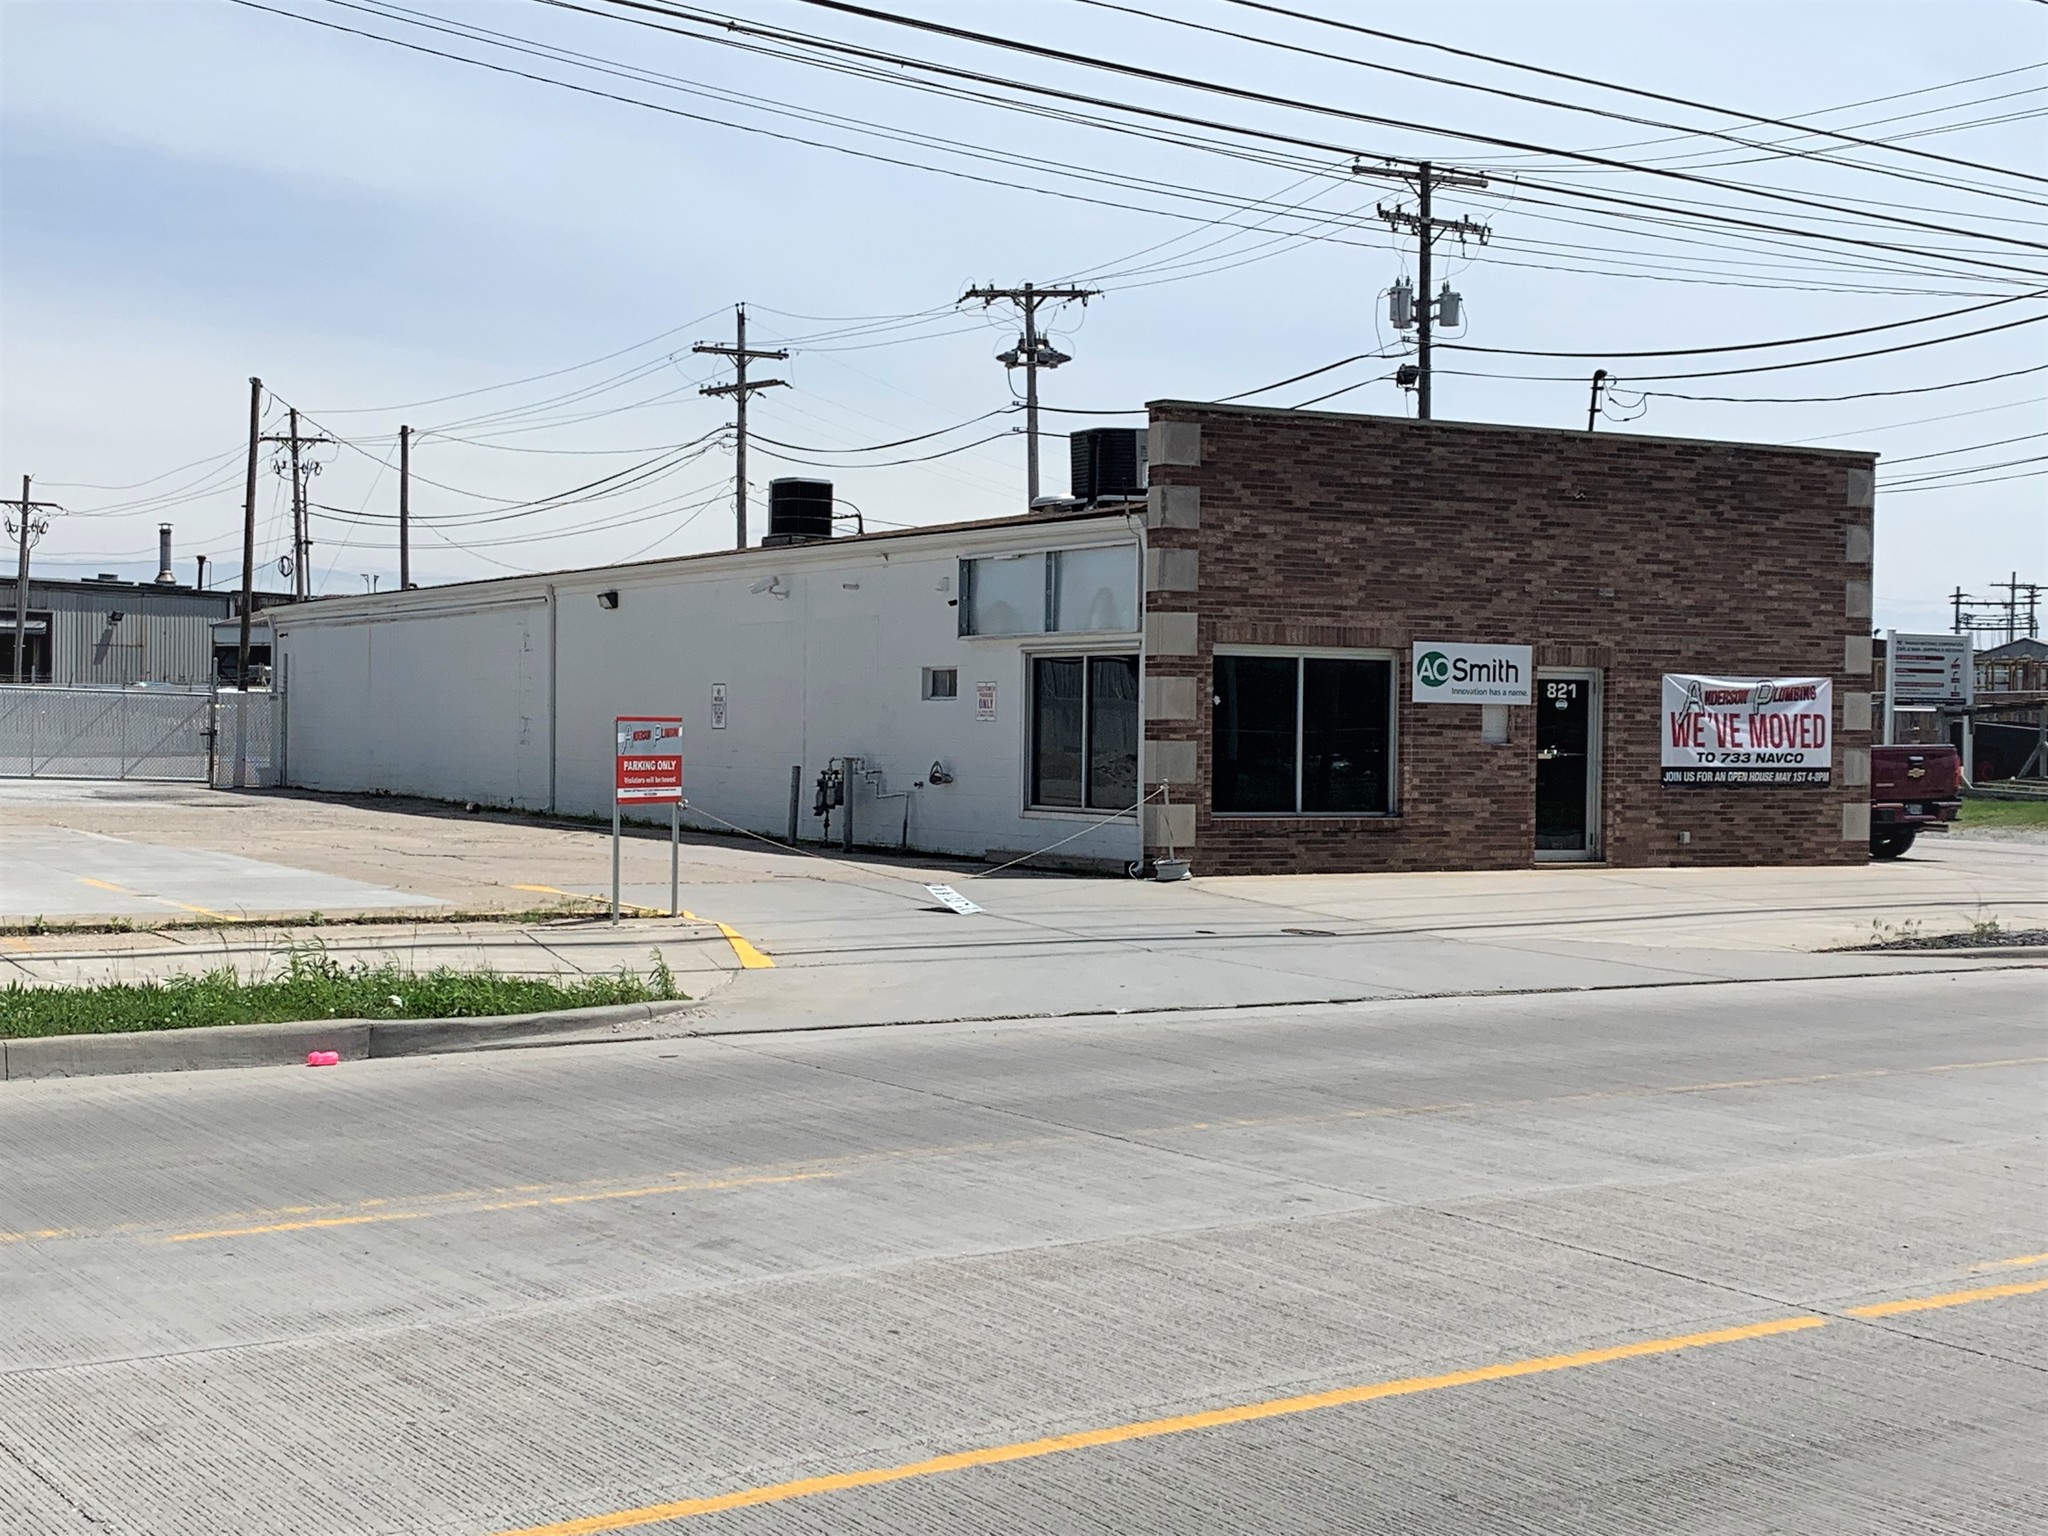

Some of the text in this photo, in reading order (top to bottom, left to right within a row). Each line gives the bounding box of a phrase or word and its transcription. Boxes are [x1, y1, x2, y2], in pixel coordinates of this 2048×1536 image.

[1452, 657, 1519, 683] Smith
[1451, 687, 1487, 696] Innovation
[1488, 688, 1501, 696] has
[1547, 682, 1577, 698] 821
[1670, 711, 1825, 749] WE'VE MOVED
[1697, 752, 1804, 764] TO 733 NAVCO
[623, 760, 677, 771] PARKING ONLY
[623, 776, 645, 784] Violators
[1663, 771, 1682, 782] JOIN
[1683, 771, 1695, 782] US
[1696, 771, 1713, 782] FOR
[1714, 771, 1726, 782] AN
[1727, 771, 1748, 782] OPEN
[1748, 771, 1774, 782] HOUSE
[1774, 771, 1792, 782] MAY
[1793, 771, 1807, 782] 1ST
